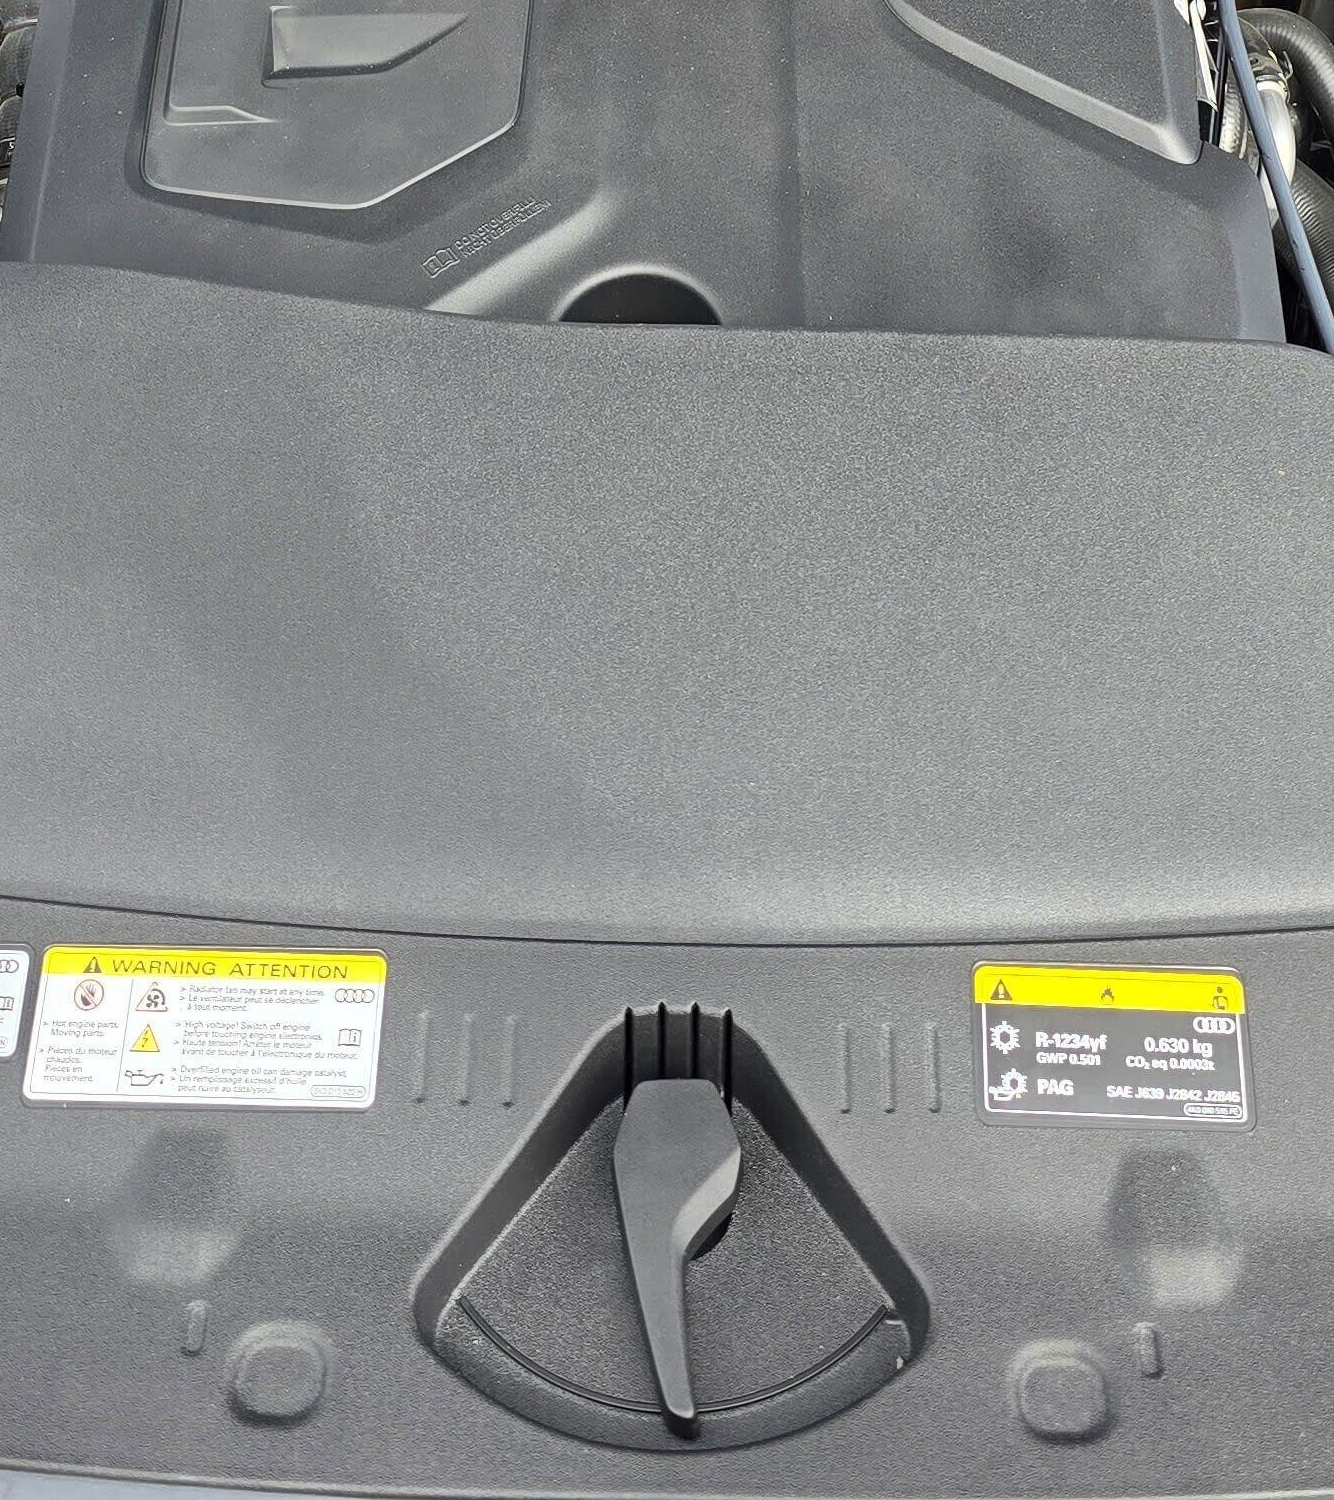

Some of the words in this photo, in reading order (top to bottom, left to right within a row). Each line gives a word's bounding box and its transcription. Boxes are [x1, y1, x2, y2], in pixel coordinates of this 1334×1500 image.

[112, 959, 217, 975] WARNING
[229, 962, 348, 979] ATTENTION
[1035, 1031, 1108, 1053] R-1234yf
[1144, 1036, 1189, 1054] 0.630
[1192, 1039, 1213, 1058] kg
[1036, 1052, 1067, 1065] GWP
[1069, 1054, 1101, 1066] 0.501
[1152, 1059, 1168, 1071] eq
[1037, 1078, 1074, 1096] PAG
[1106, 1085, 1133, 1098] SAE
